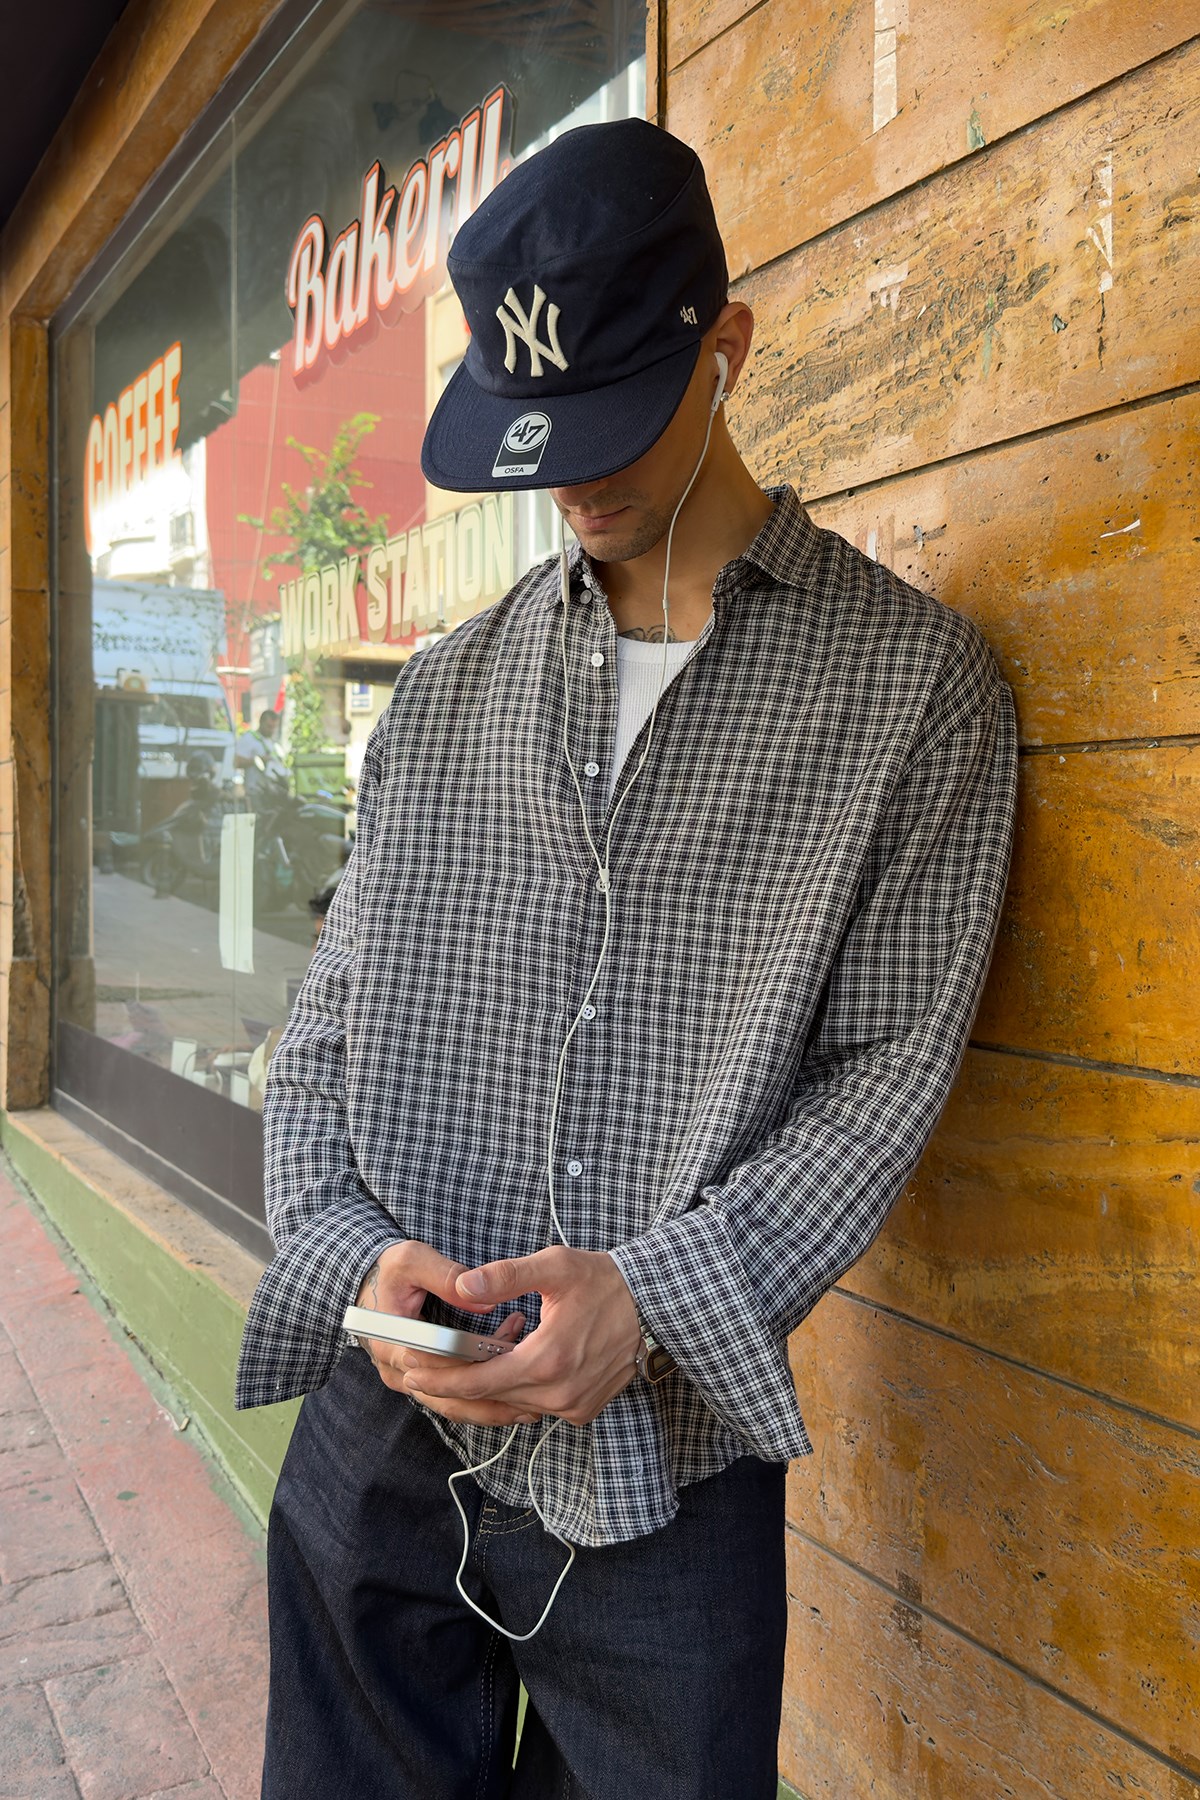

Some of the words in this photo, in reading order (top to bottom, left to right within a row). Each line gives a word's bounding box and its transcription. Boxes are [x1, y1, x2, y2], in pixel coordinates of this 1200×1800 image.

[496, 284, 570, 378] NY
[279, 553, 359, 658] WORK
[366, 491, 513, 632] STATION
